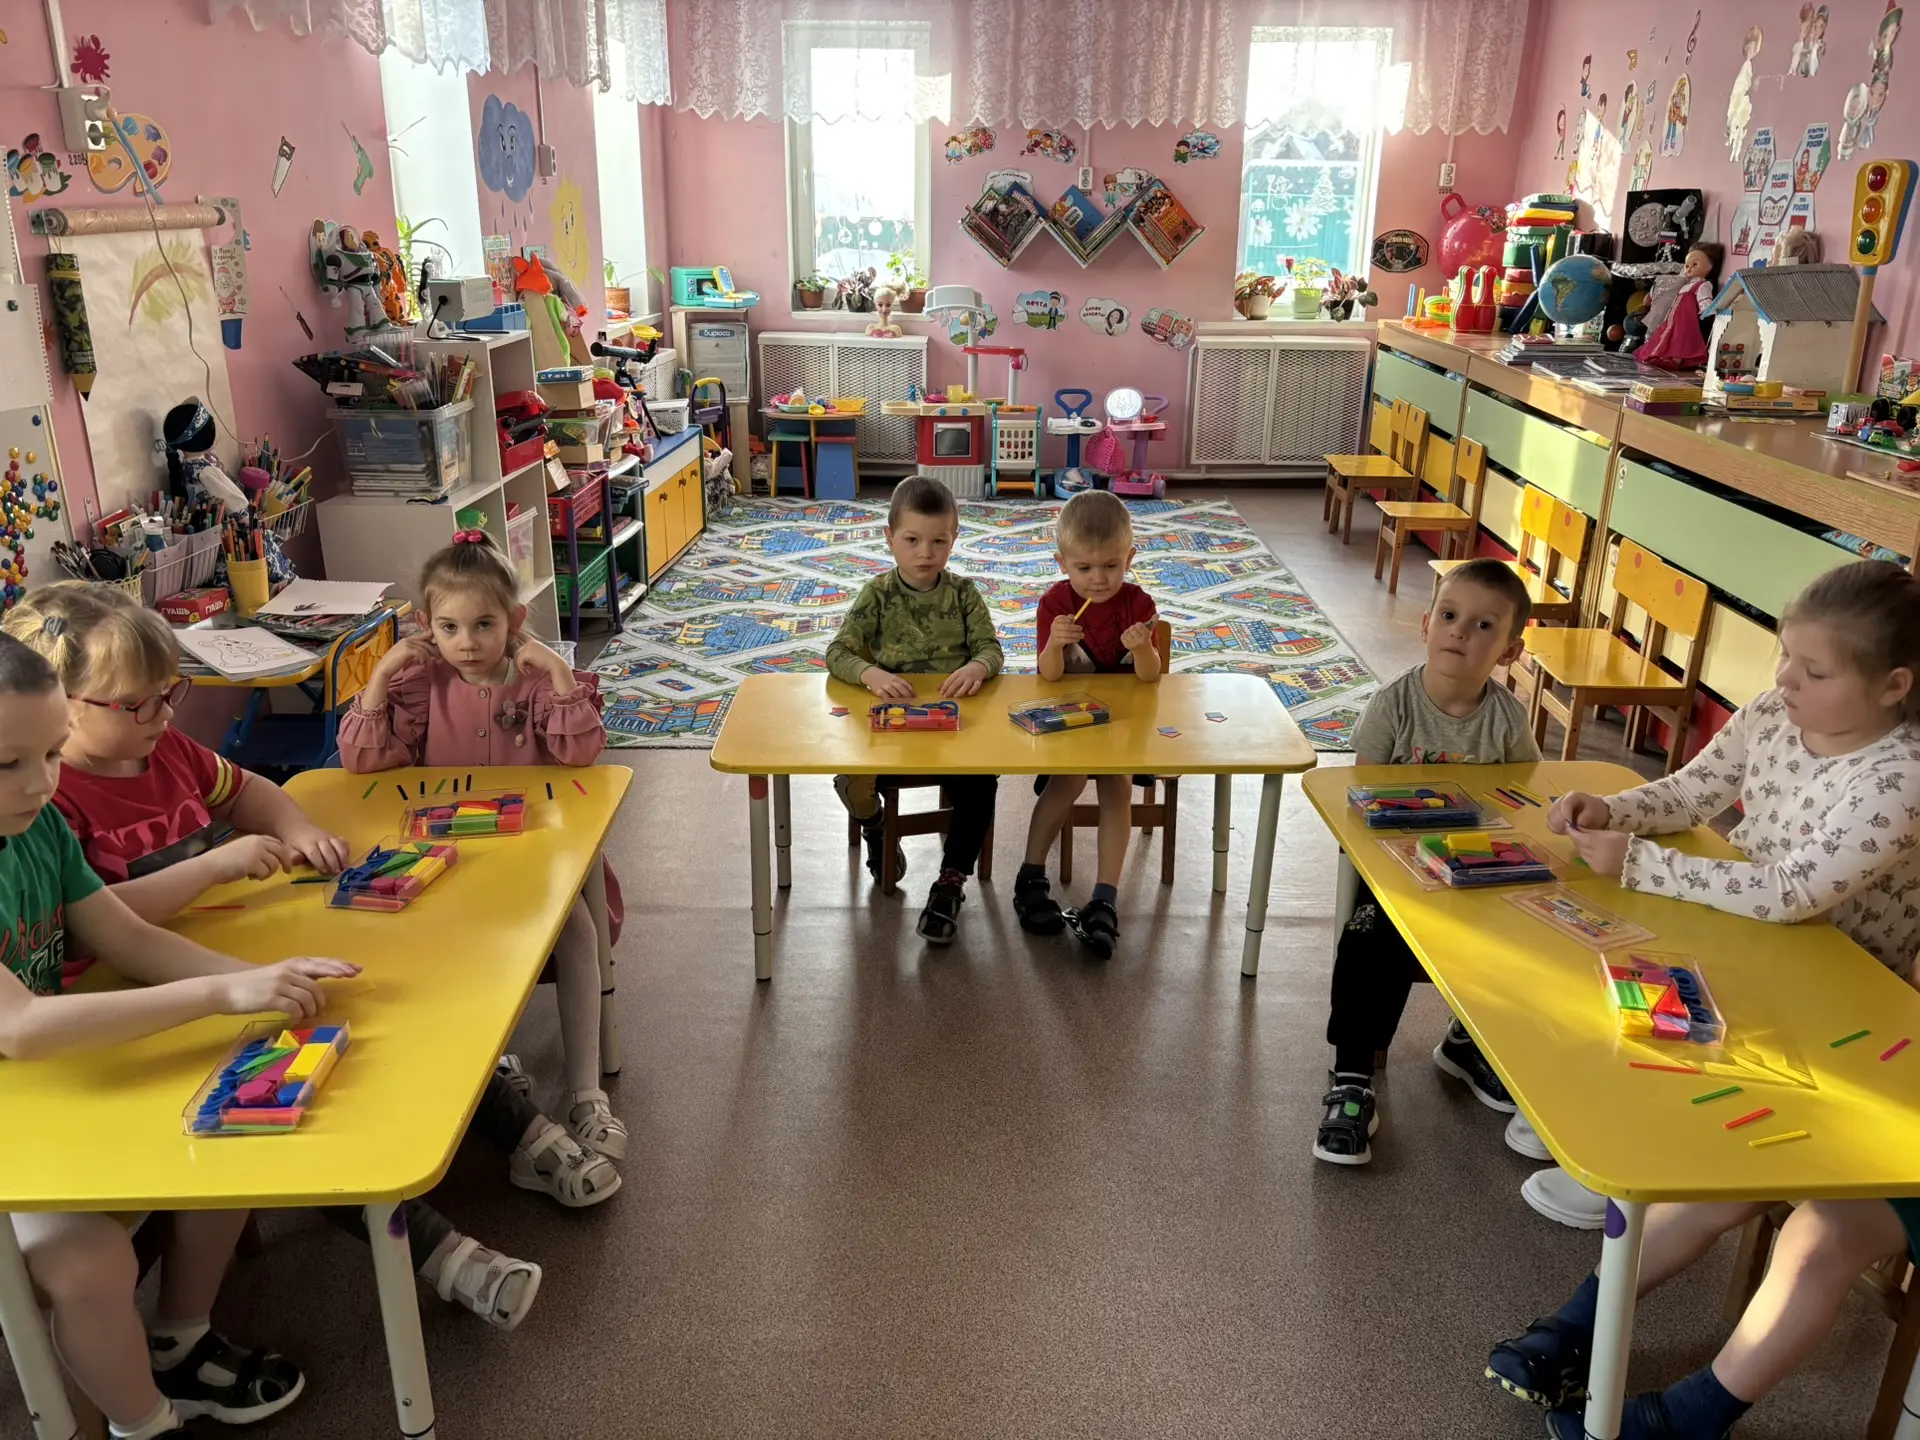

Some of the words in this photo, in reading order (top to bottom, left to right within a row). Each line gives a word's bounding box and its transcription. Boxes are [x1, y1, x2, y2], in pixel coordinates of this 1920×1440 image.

[1026, 300, 1048, 308] ПОЧТА
[161, 607, 190, 616] ГУАШЬ
[205, 600, 224, 615] ГУАШЬ
